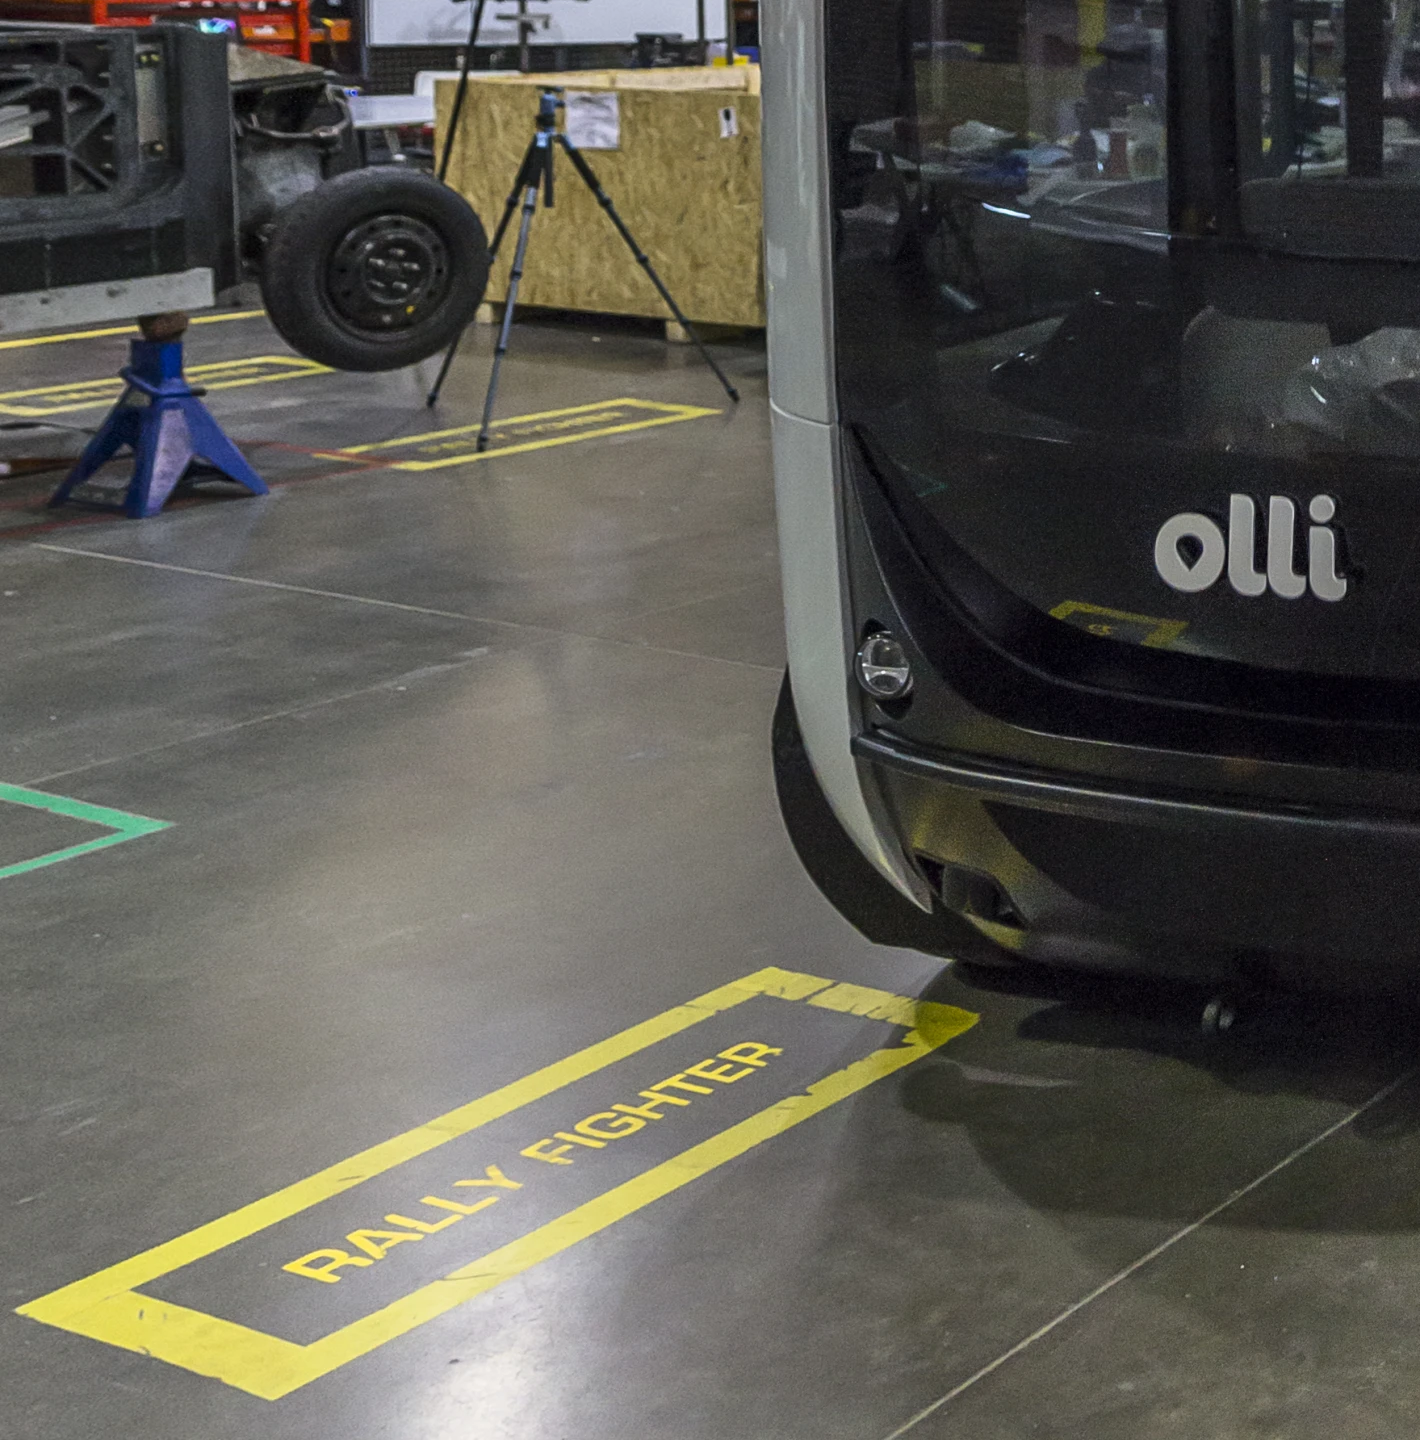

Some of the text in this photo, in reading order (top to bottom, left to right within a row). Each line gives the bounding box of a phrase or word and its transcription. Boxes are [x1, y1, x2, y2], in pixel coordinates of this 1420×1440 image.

[1154, 493, 1347, 601] olli
[282, 1042, 784, 1283] RALLY FIGHTER
